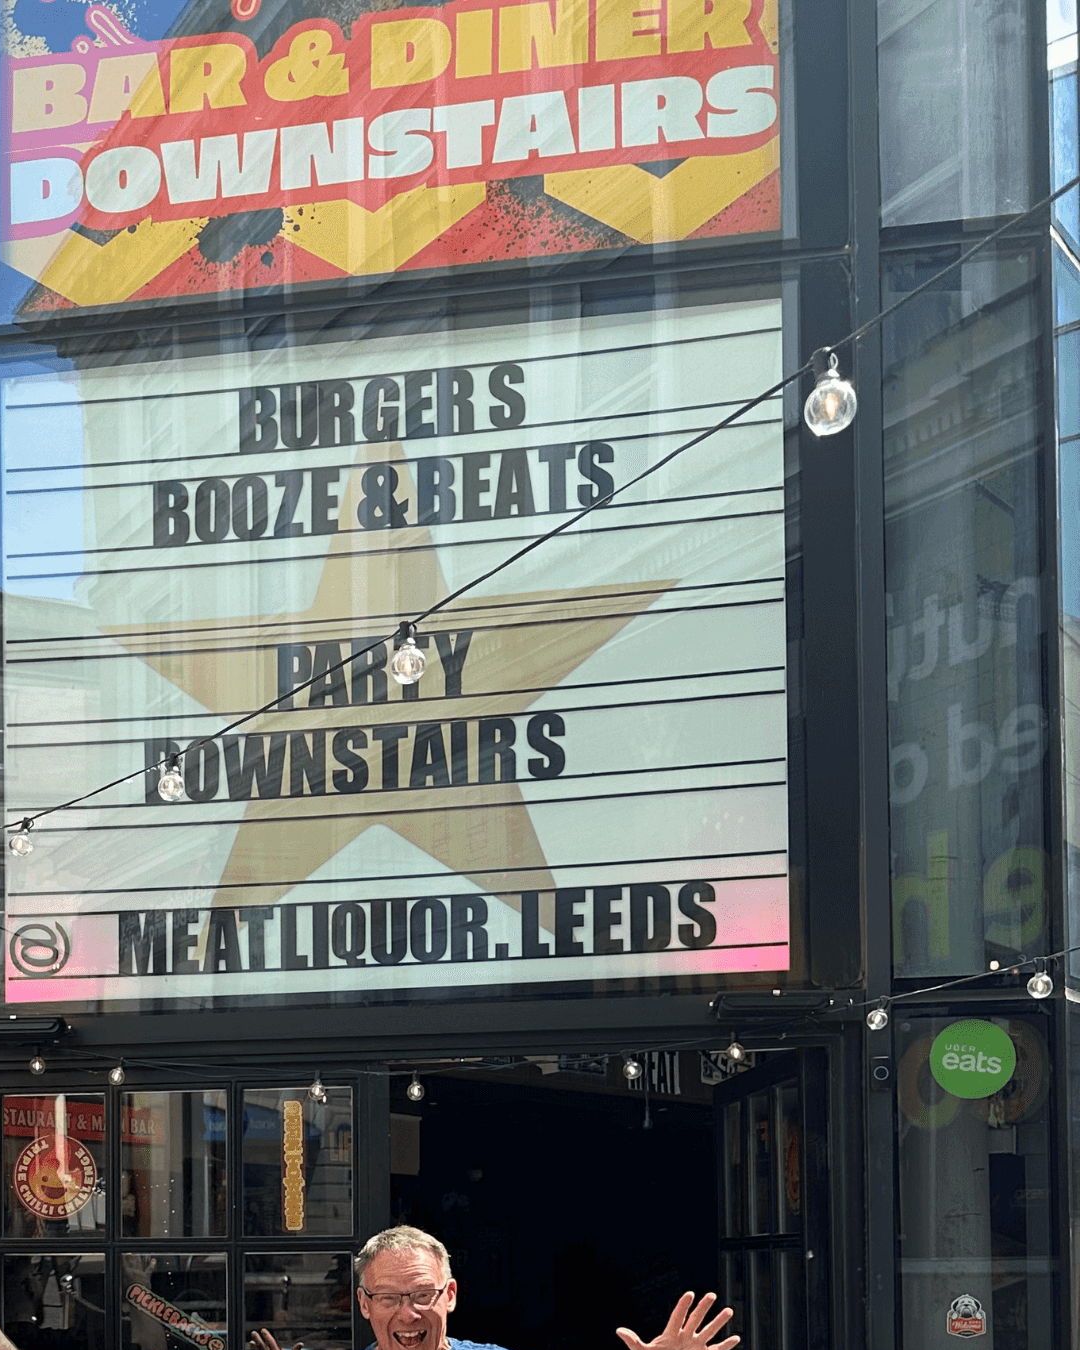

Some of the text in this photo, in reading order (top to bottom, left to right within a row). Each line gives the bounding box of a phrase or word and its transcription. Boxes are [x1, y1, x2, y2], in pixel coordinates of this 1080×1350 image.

[12, 0, 757, 134] BAR & DINER
[10, 65, 778, 225] DOWNSTAIRS
[239, 363, 526, 453] BURGERS
[153, 468, 338, 547] BOOZE
[277, 631, 473, 710] PARTY
[145, 713, 566, 804] DOWNSTAIRS
[9, 921, 70, 978] @
[942, 1051, 1002, 1074] eats
[944, 1043, 976, 1052] UBER
[18, 1140, 94, 1215] TRIPLE CHILLI CHALLENGE
[130, 1285, 209, 1345] PICKLEBACKS
